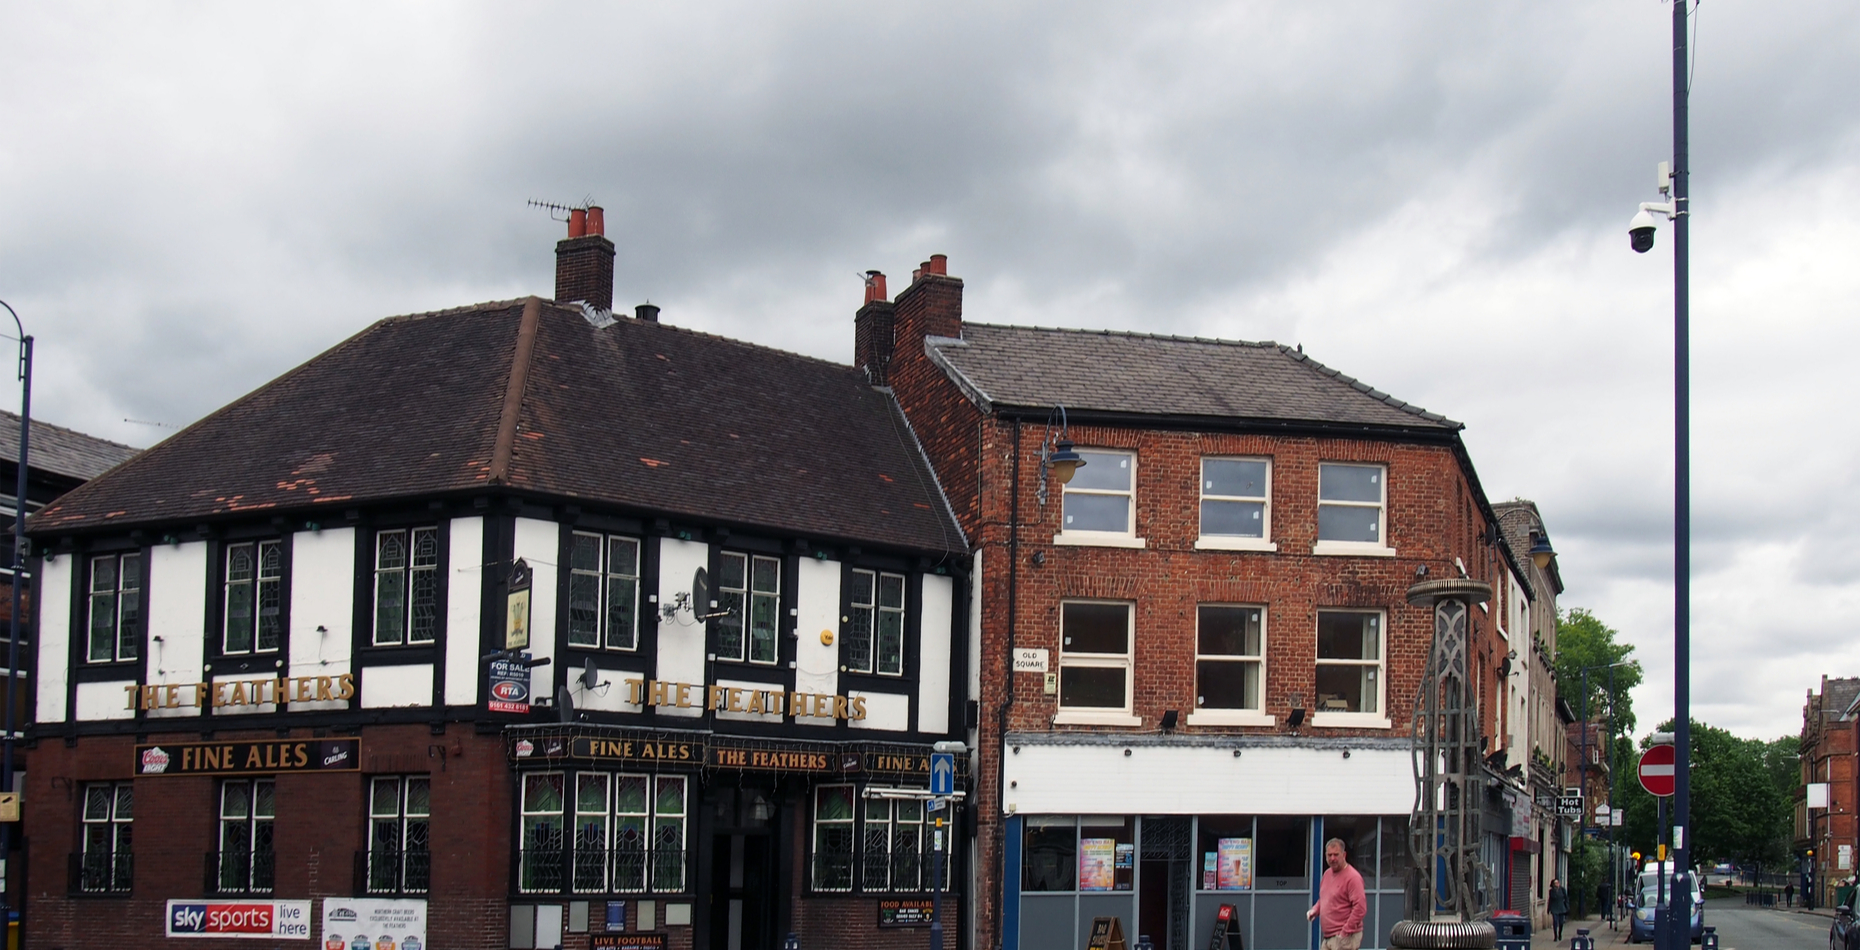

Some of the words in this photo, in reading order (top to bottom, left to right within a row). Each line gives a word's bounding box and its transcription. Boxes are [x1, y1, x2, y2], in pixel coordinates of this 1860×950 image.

[491, 662, 508, 670] FOR
[510, 663, 530, 673] SALE
[124, 683, 180, 710] THE
[194, 673, 355, 709] FEATHERS
[500, 686, 519, 696] RTA
[624, 678, 692, 708] THE
[708, 684, 867, 720] FEATHERS
[143, 750, 168, 764] Coors
[182, 745, 235, 770] FINE
[245, 743, 308, 768] ALES
[590, 740, 634, 757] FINE
[642, 743, 690, 760] ALES
[324, 750, 348, 766] CARLING
[717, 750, 747, 765] THE
[753, 752, 827, 769] FEATHERS
[877, 755, 912, 771] FINE
[1561, 798, 1579, 806] Hot
[1558, 806, 1581, 814] Tubs
[175, 906, 205, 931] sky
[210, 908, 269, 931] sports
[280, 904, 300, 918] live
[280, 921, 307, 935] here
[594, 937, 614, 945] LIVE
[618, 937, 662, 945] FOOTBALL
